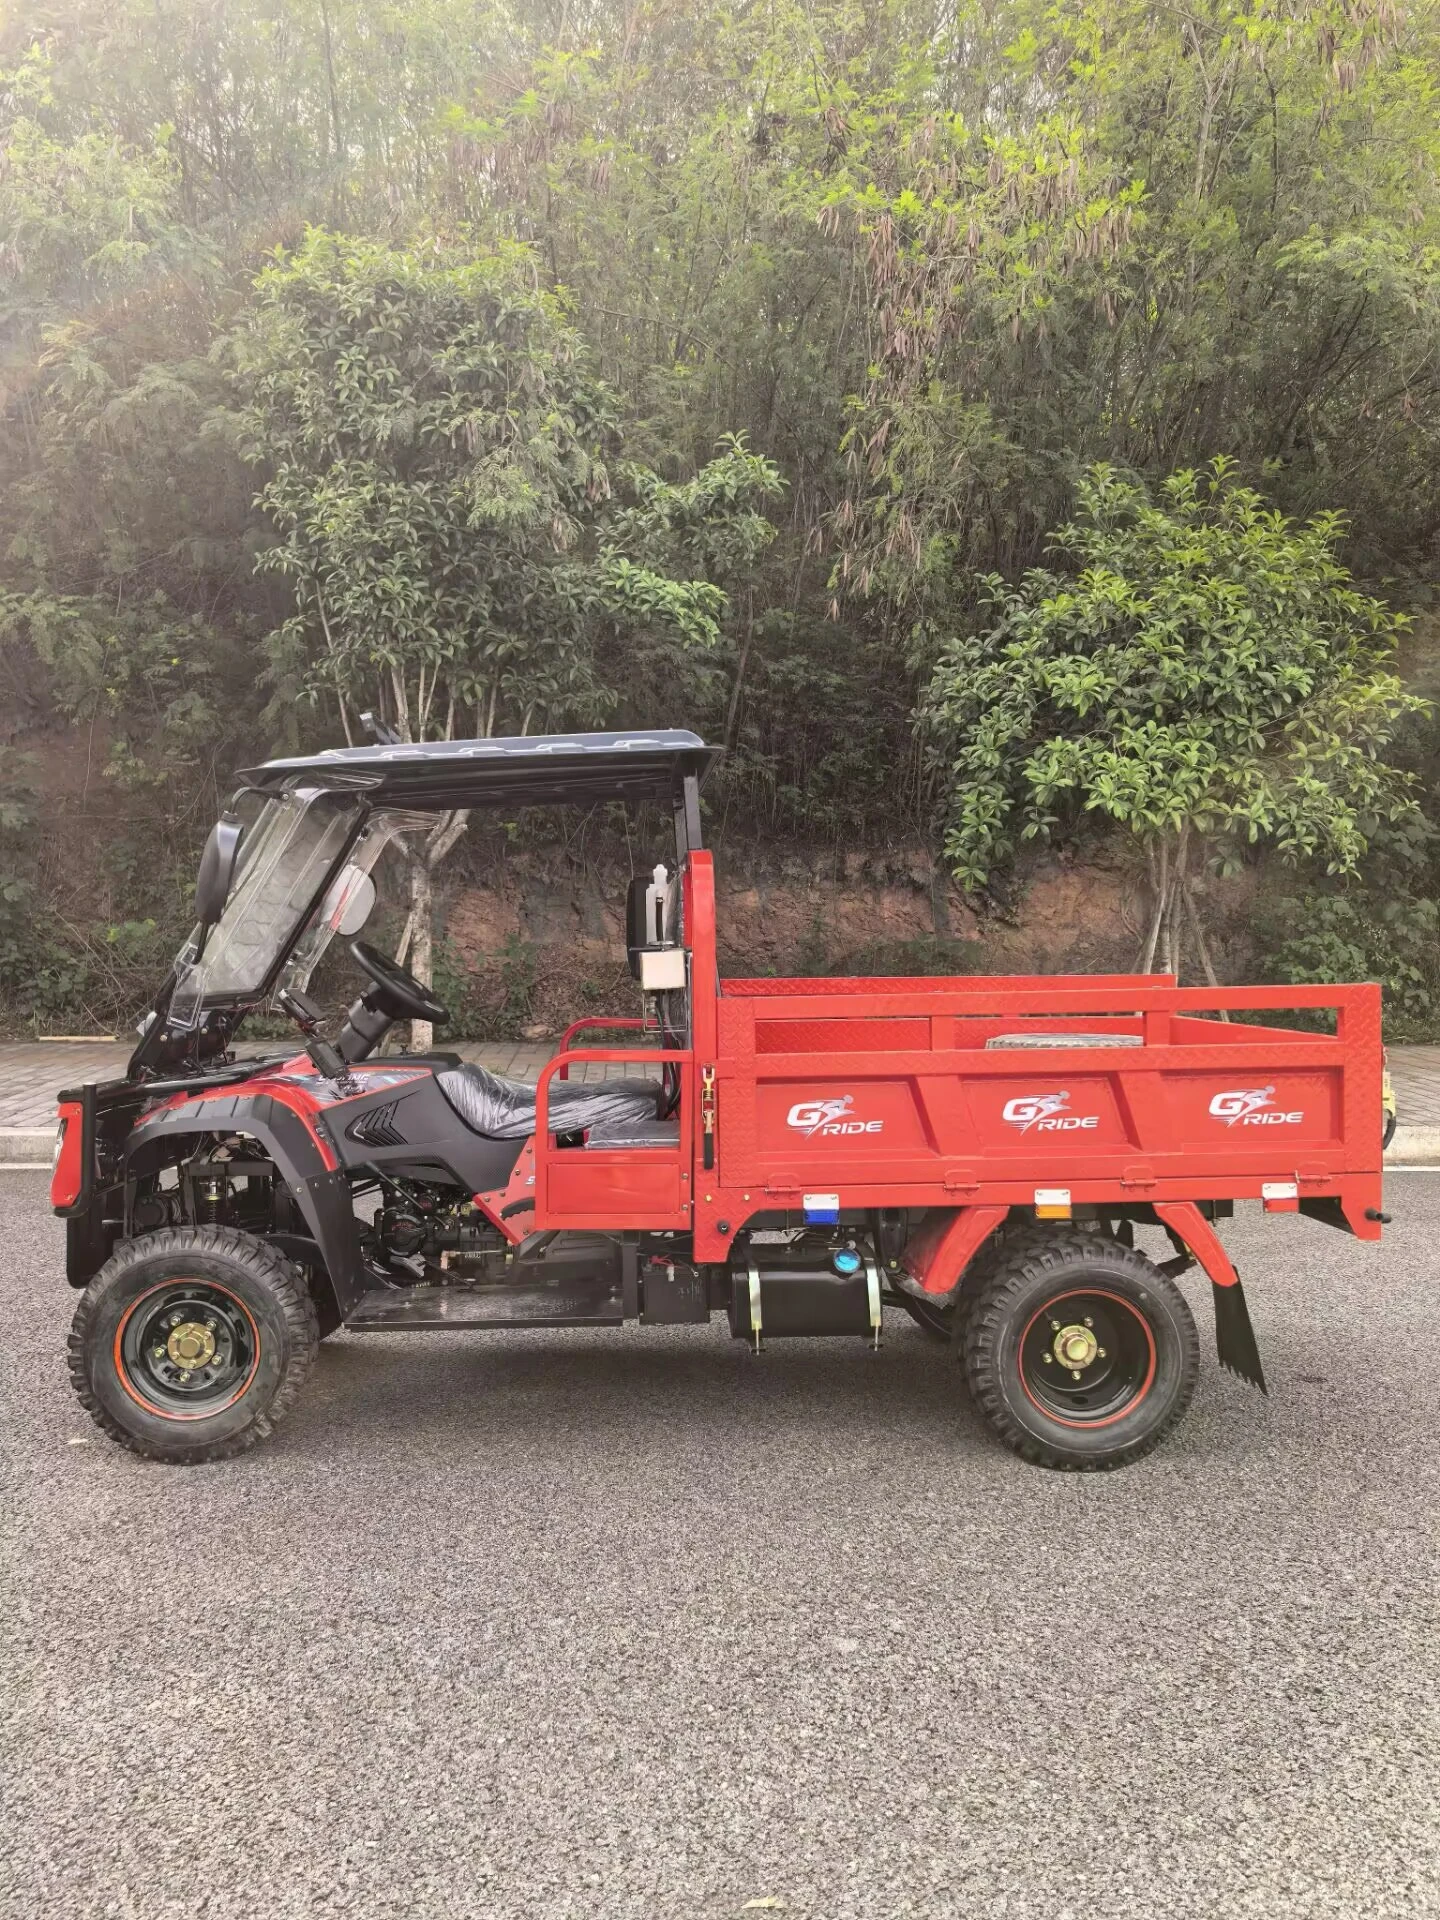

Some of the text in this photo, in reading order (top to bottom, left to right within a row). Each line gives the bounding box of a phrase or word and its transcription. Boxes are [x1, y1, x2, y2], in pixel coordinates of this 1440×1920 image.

[1037, 1116, 1100, 1131] RIDE
[1243, 1112, 1305, 1125] RIDE
[822, 1120, 884, 1136] RIDE
